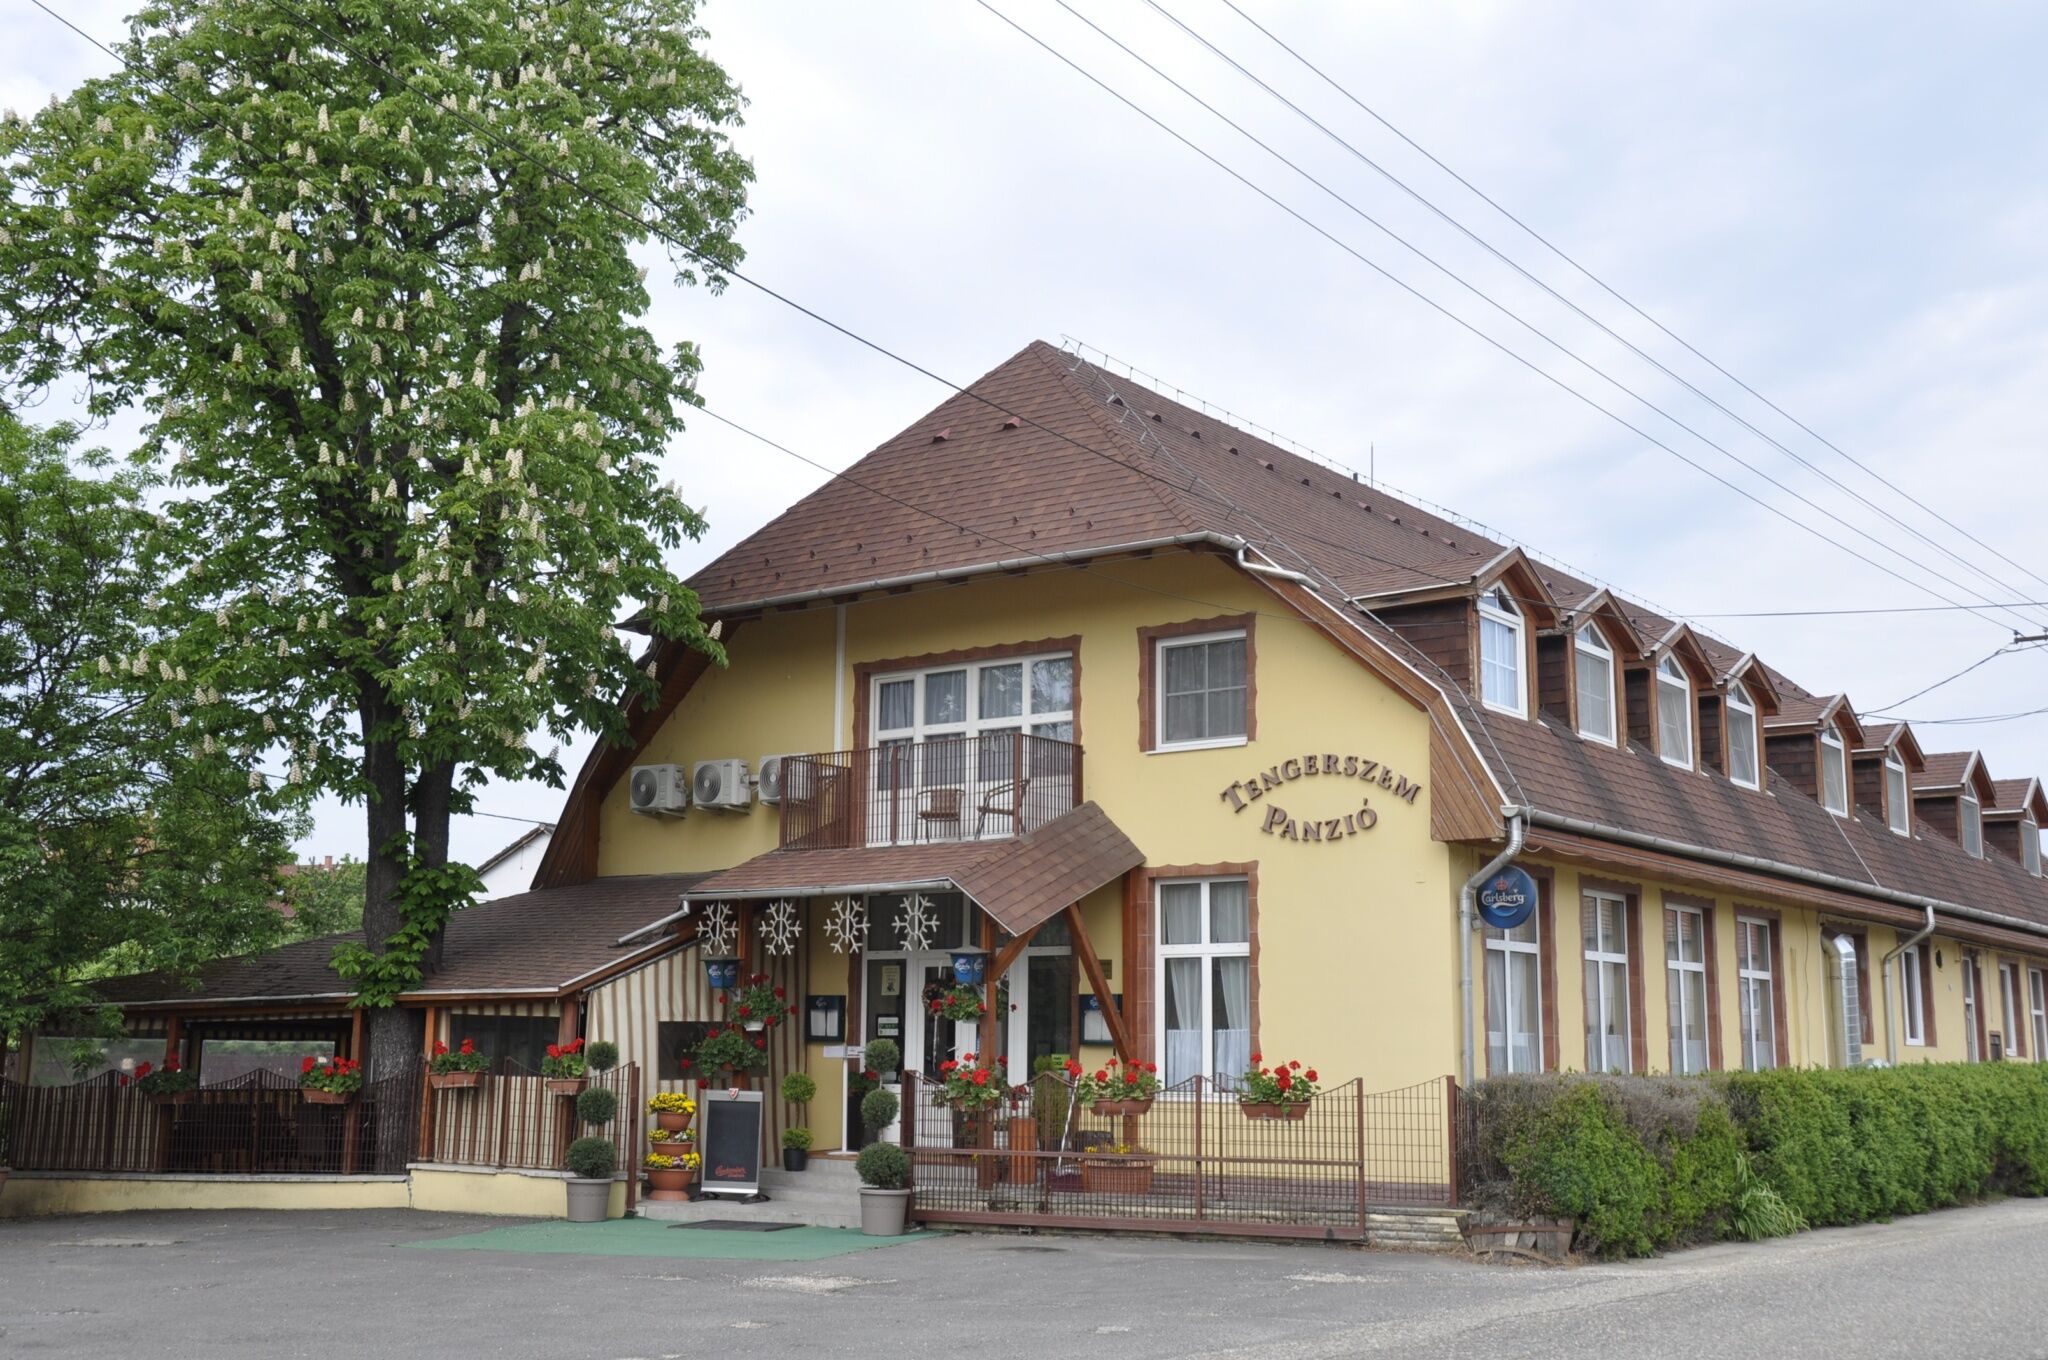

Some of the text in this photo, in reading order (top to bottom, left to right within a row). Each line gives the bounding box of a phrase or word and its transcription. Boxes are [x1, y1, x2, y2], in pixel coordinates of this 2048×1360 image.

[1220, 754, 1421, 814] TENGERSZEM
[1261, 798, 1378, 842] PANZIÓ
[1481, 890, 1525, 906] Carlsberg
